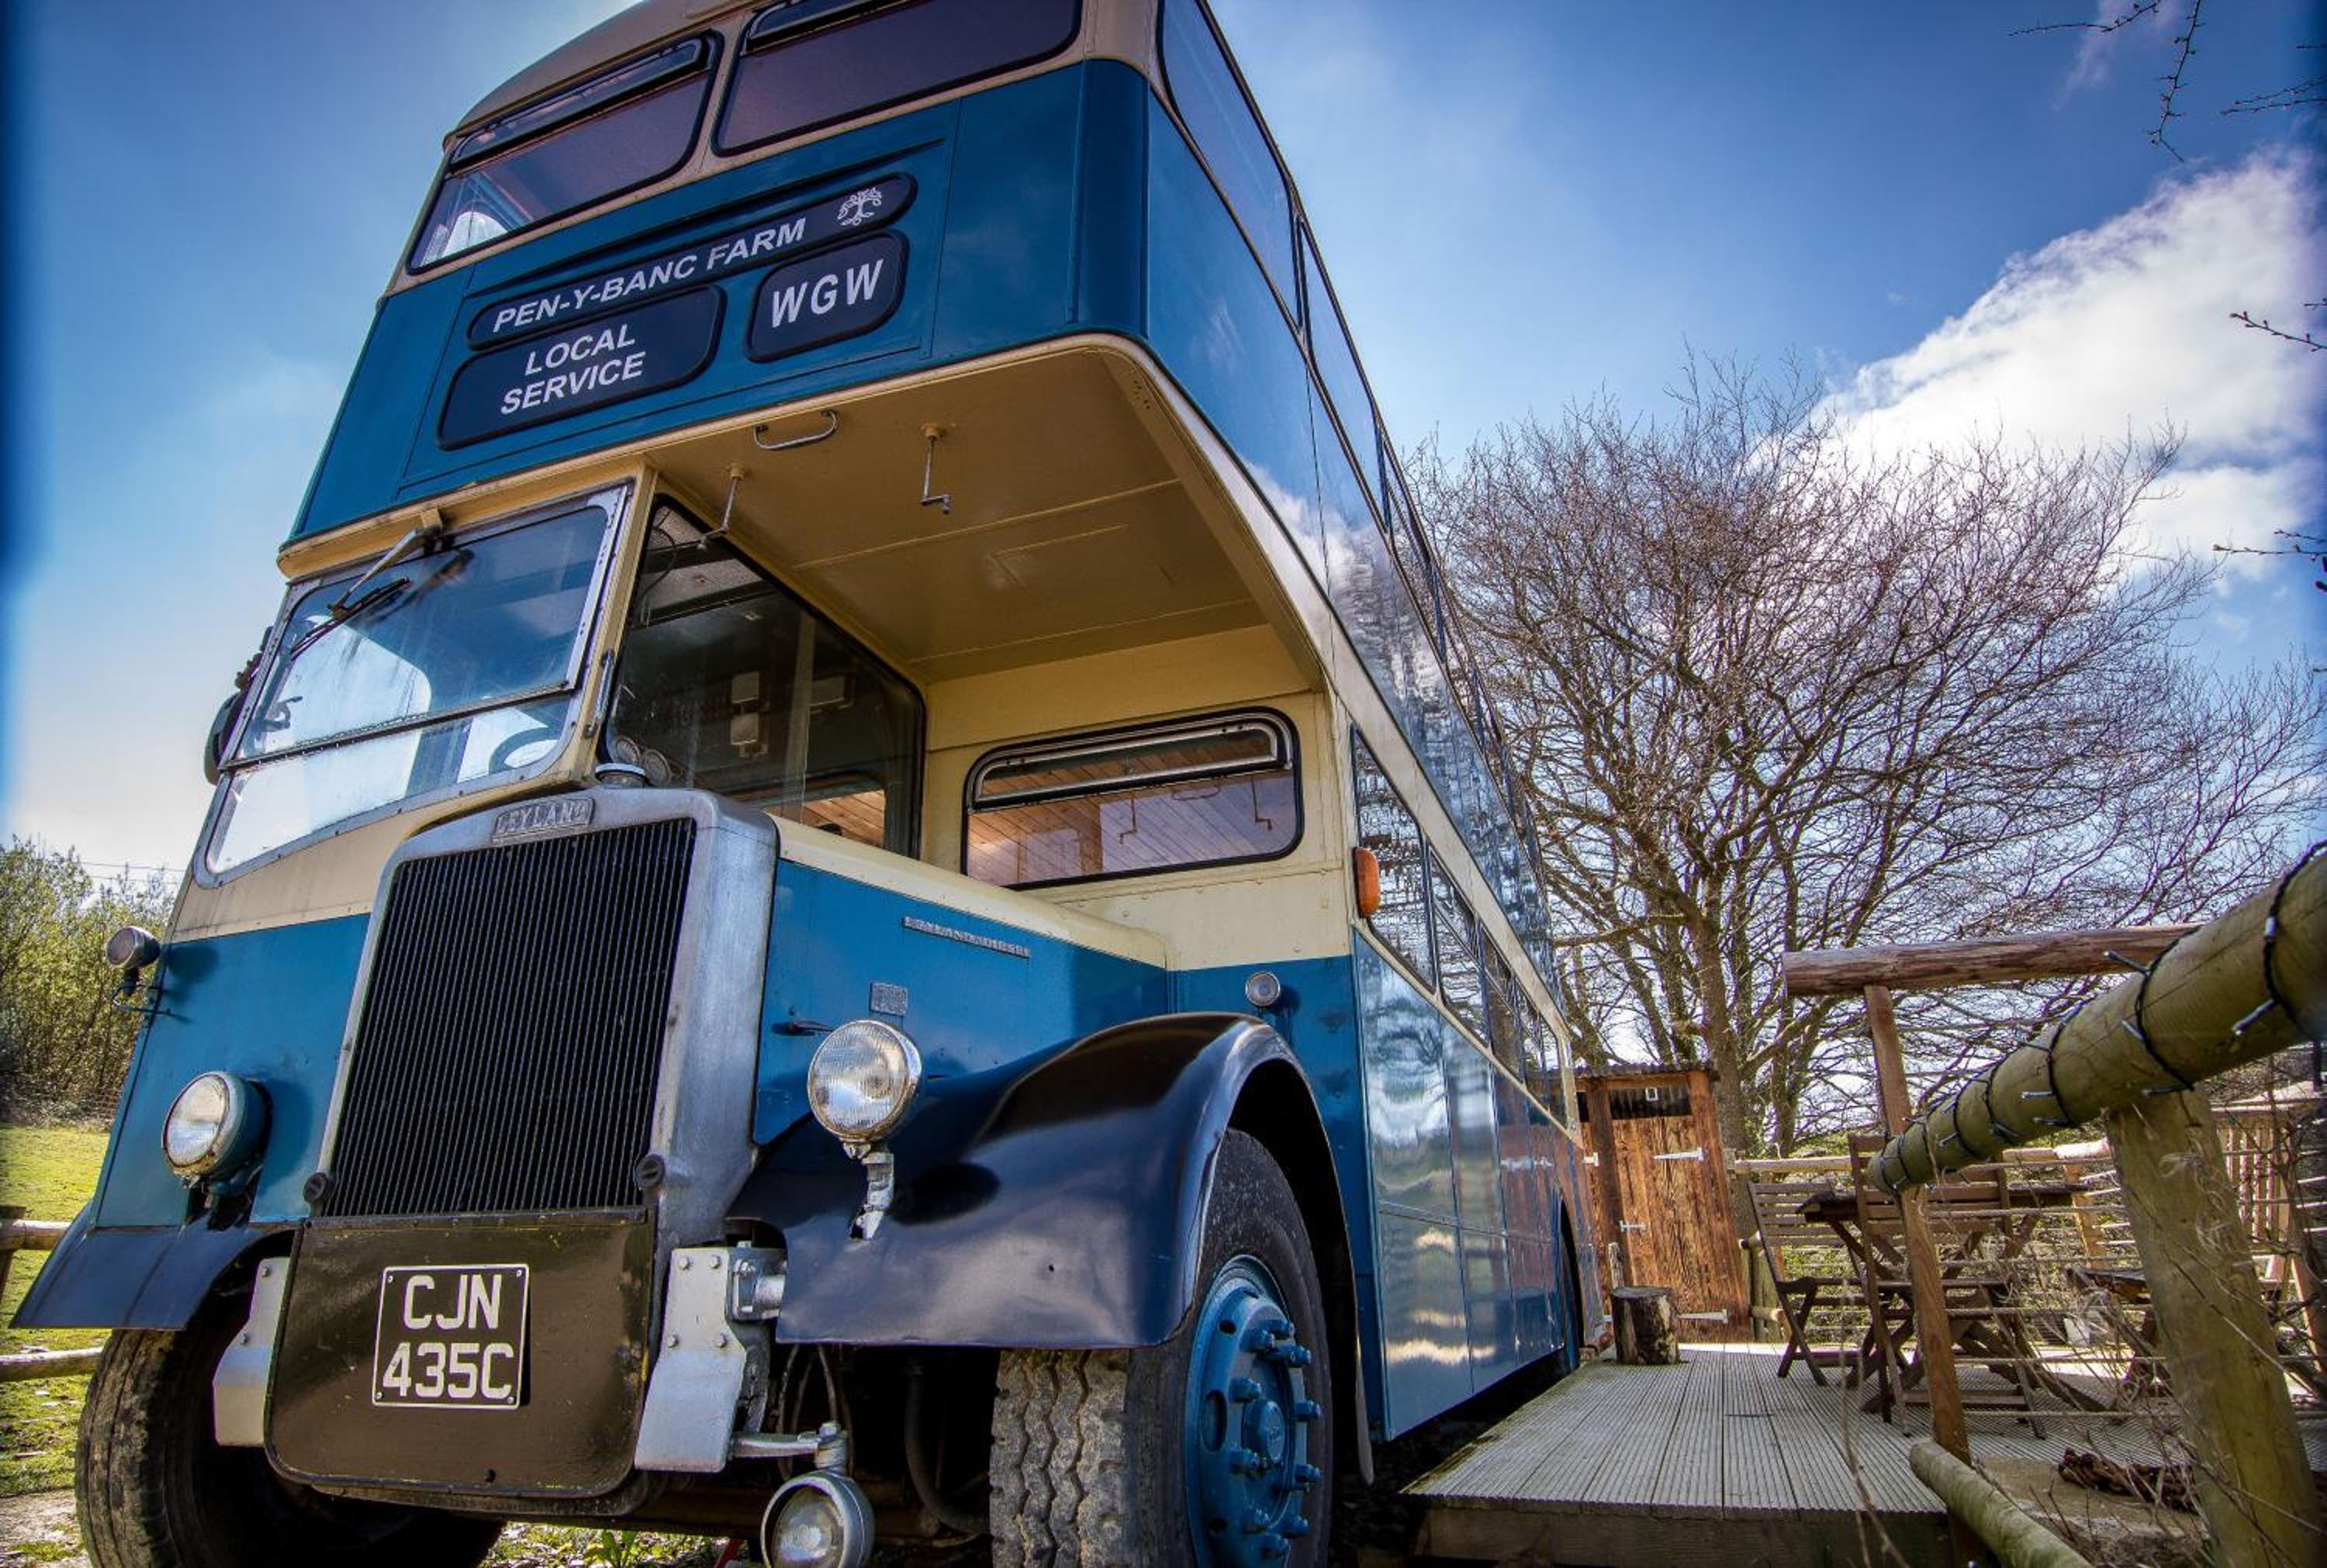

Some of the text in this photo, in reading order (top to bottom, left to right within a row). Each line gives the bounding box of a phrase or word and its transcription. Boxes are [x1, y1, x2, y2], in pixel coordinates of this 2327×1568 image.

[493, 218, 807, 333] PEN-Y-BANC FARM
[771, 260, 885, 327] WGW
[524, 323, 635, 375] LOCAL
[500, 351, 645, 414] SERVICE
[404, 1274, 502, 1329] CJN
[382, 1342, 514, 1399] 435C
